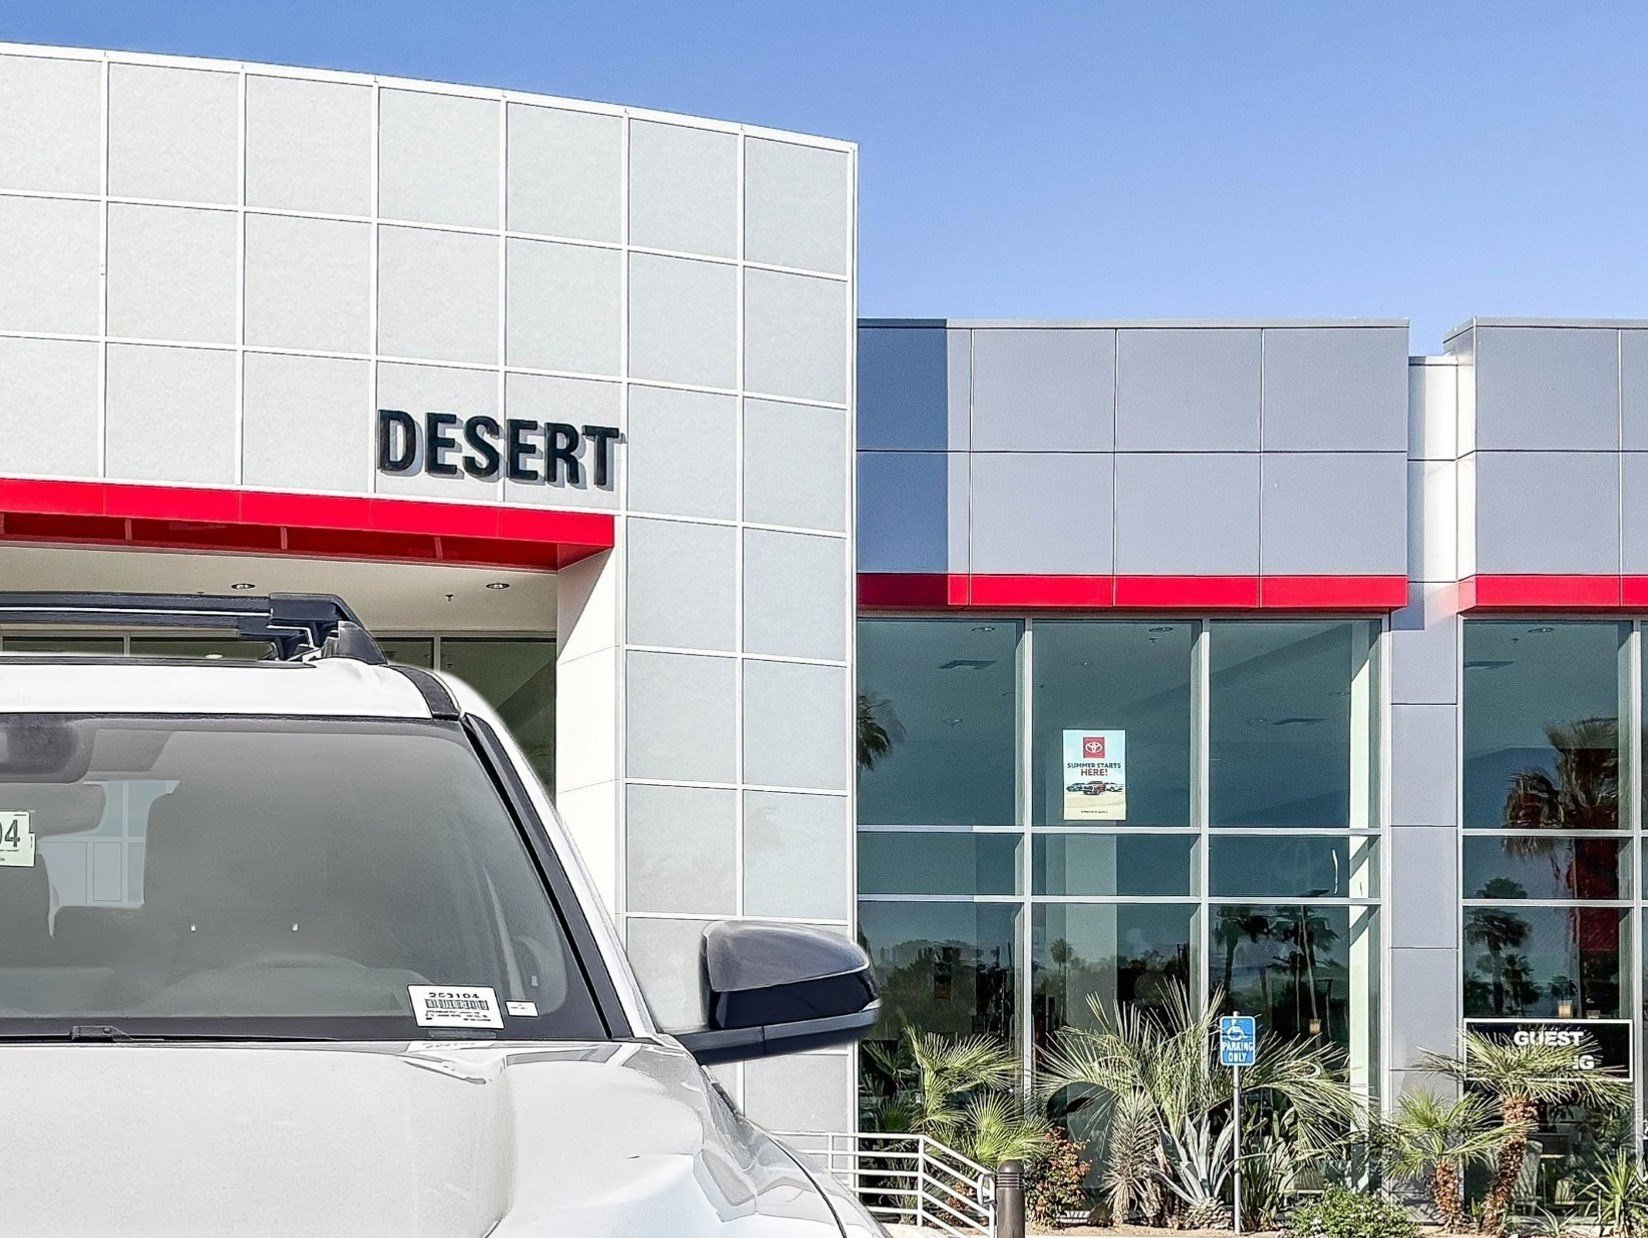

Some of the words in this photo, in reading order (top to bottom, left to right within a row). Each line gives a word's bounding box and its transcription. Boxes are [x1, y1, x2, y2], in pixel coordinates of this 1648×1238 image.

[378, 409, 620, 488] DESERT
[1513, 1031, 1584, 1046] GUEST
[1222, 1041, 1253, 1052] PARKING
[1228, 1052, 1248, 1062] ONLY
